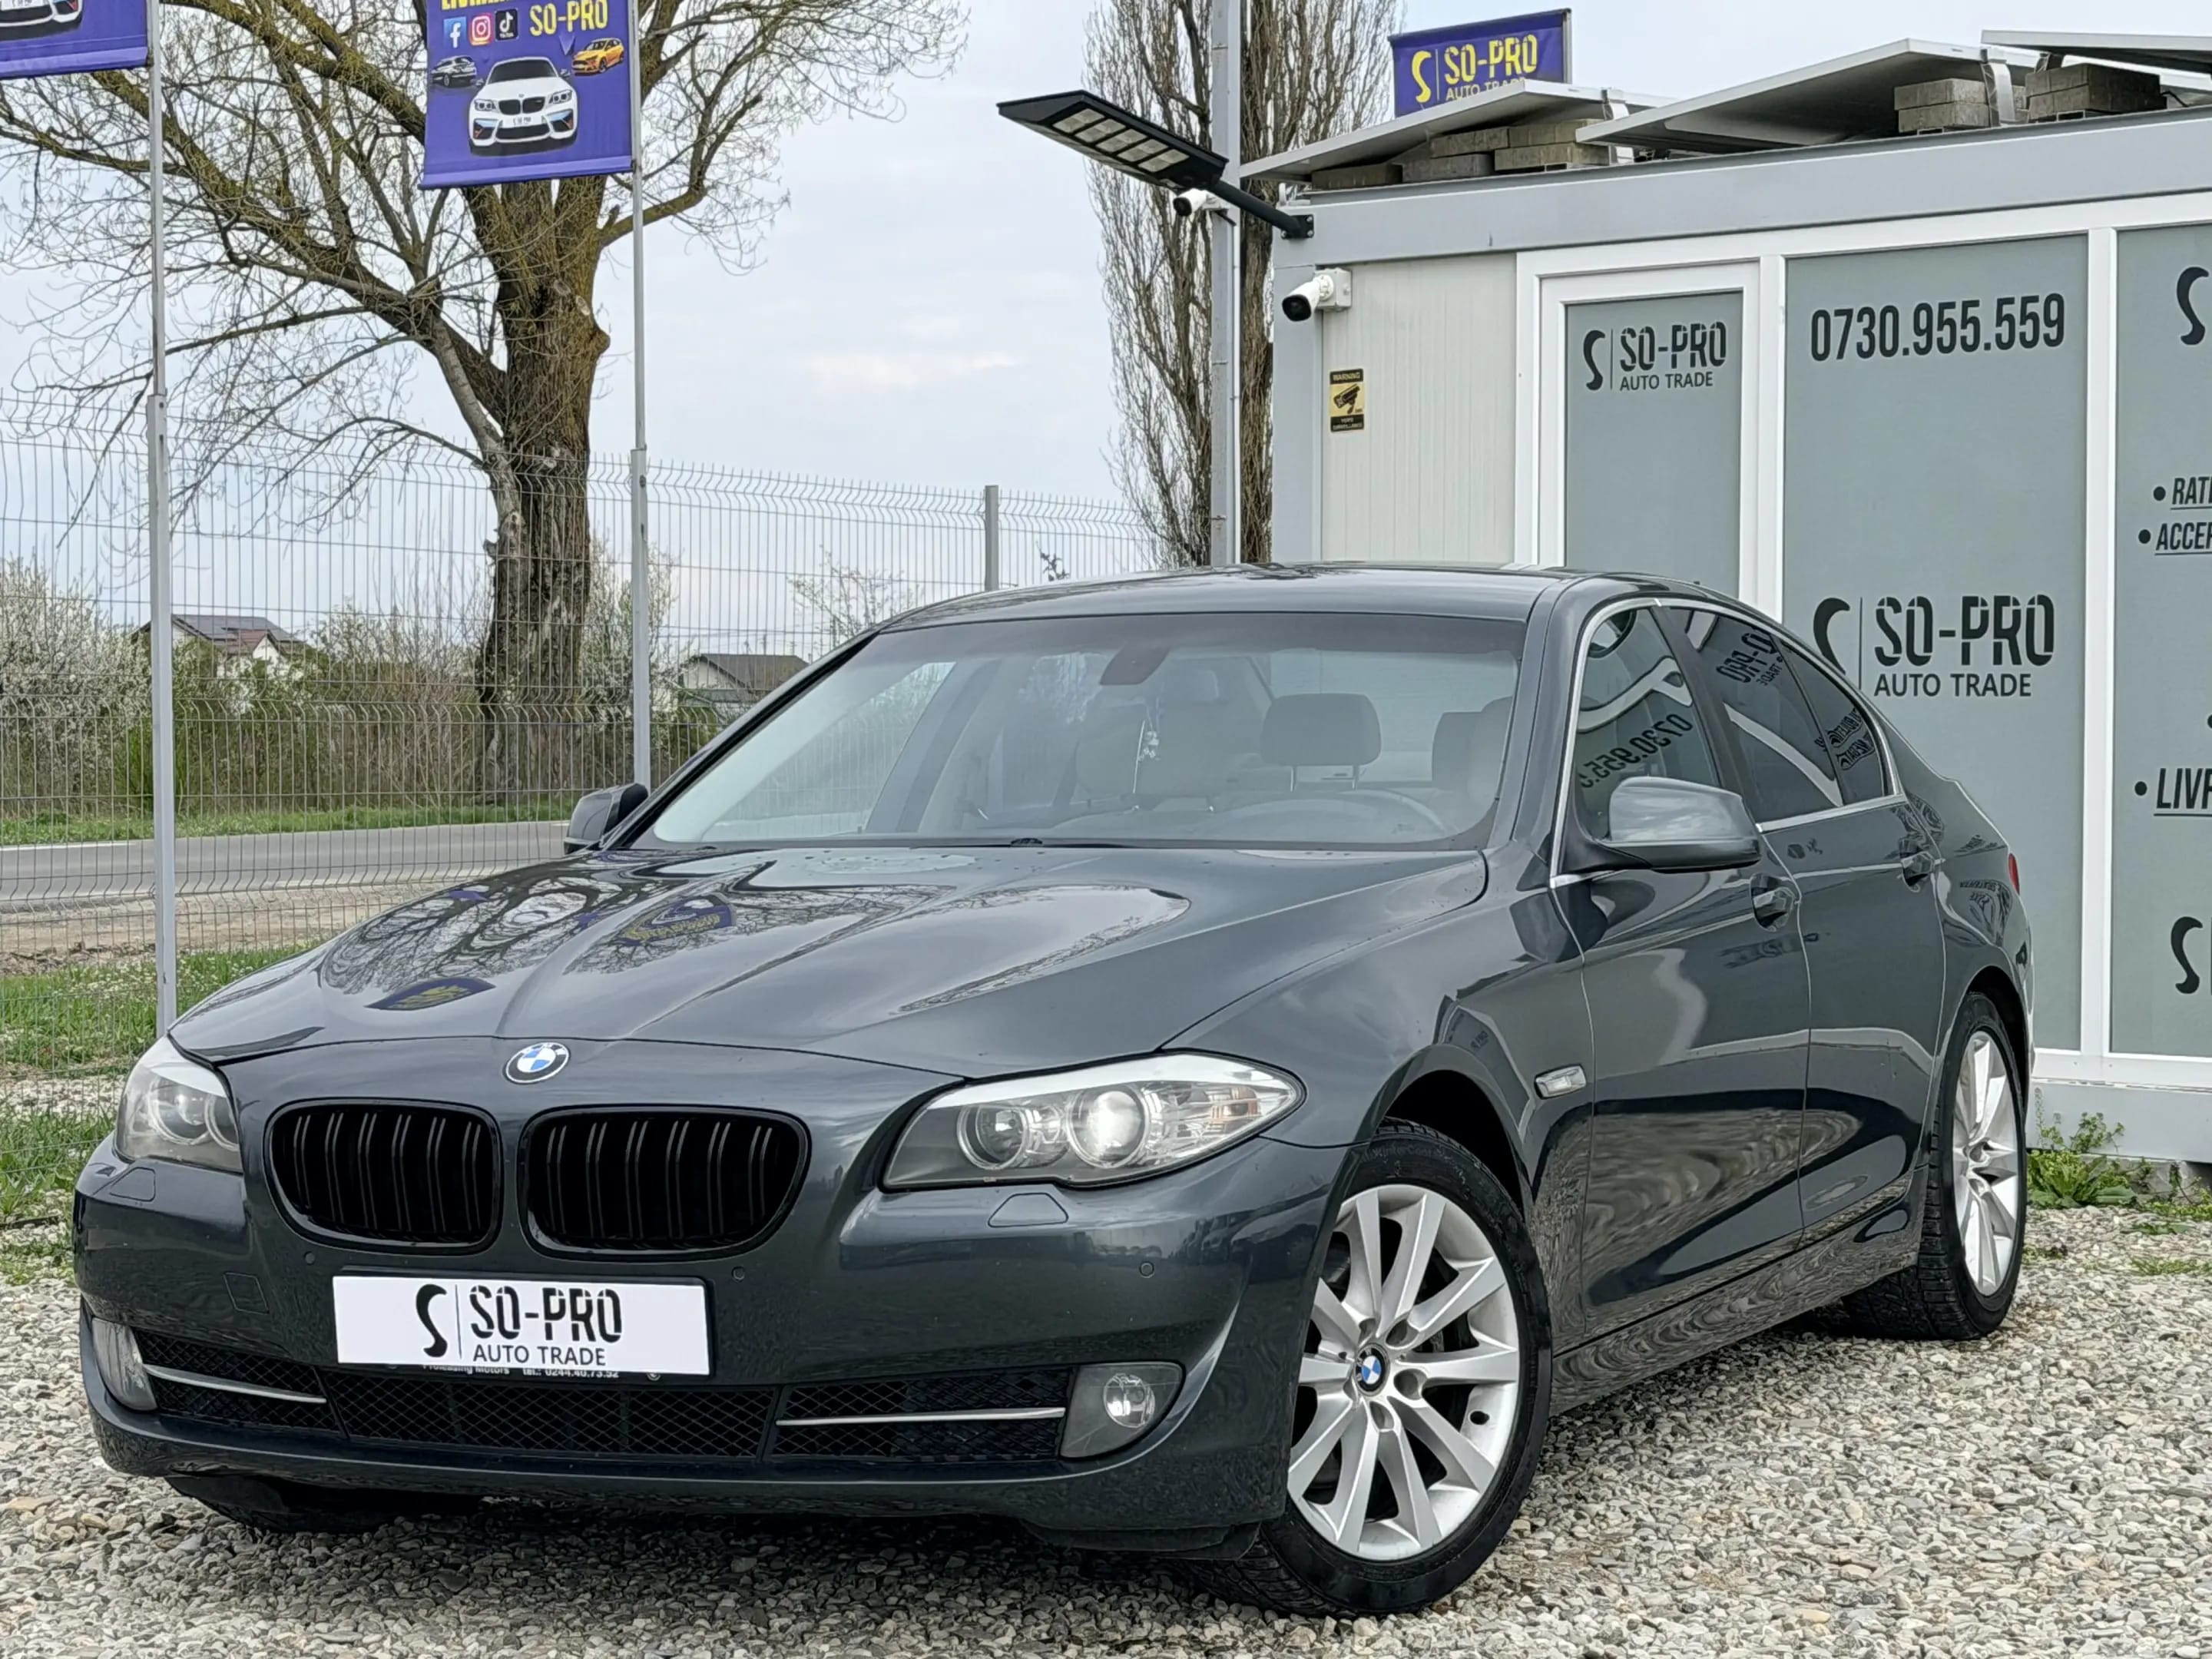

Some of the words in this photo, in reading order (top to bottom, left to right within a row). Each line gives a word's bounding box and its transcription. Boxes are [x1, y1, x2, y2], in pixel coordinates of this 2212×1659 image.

[530, 0, 608, 36] SO-PRO
[1444, 34, 1538, 84] SO-PRO
[1445, 84, 1480, 101] AUTO
[1619, 321, 1727, 372] SO-PRO
[1811, 293, 2065, 362] 0730.955.559
[1620, 374, 1659, 392] AUTO
[1665, 371, 1714, 389] TRADE
[1874, 594, 2055, 667] SO-PRO
[1874, 673, 1941, 697] AUTO
[1950, 673, 2032, 697] TRADE
[469, 1285, 622, 1343] SO-PRO
[473, 1345, 529, 1363] AUTO
[537, 1346, 606, 1366] TRADE
